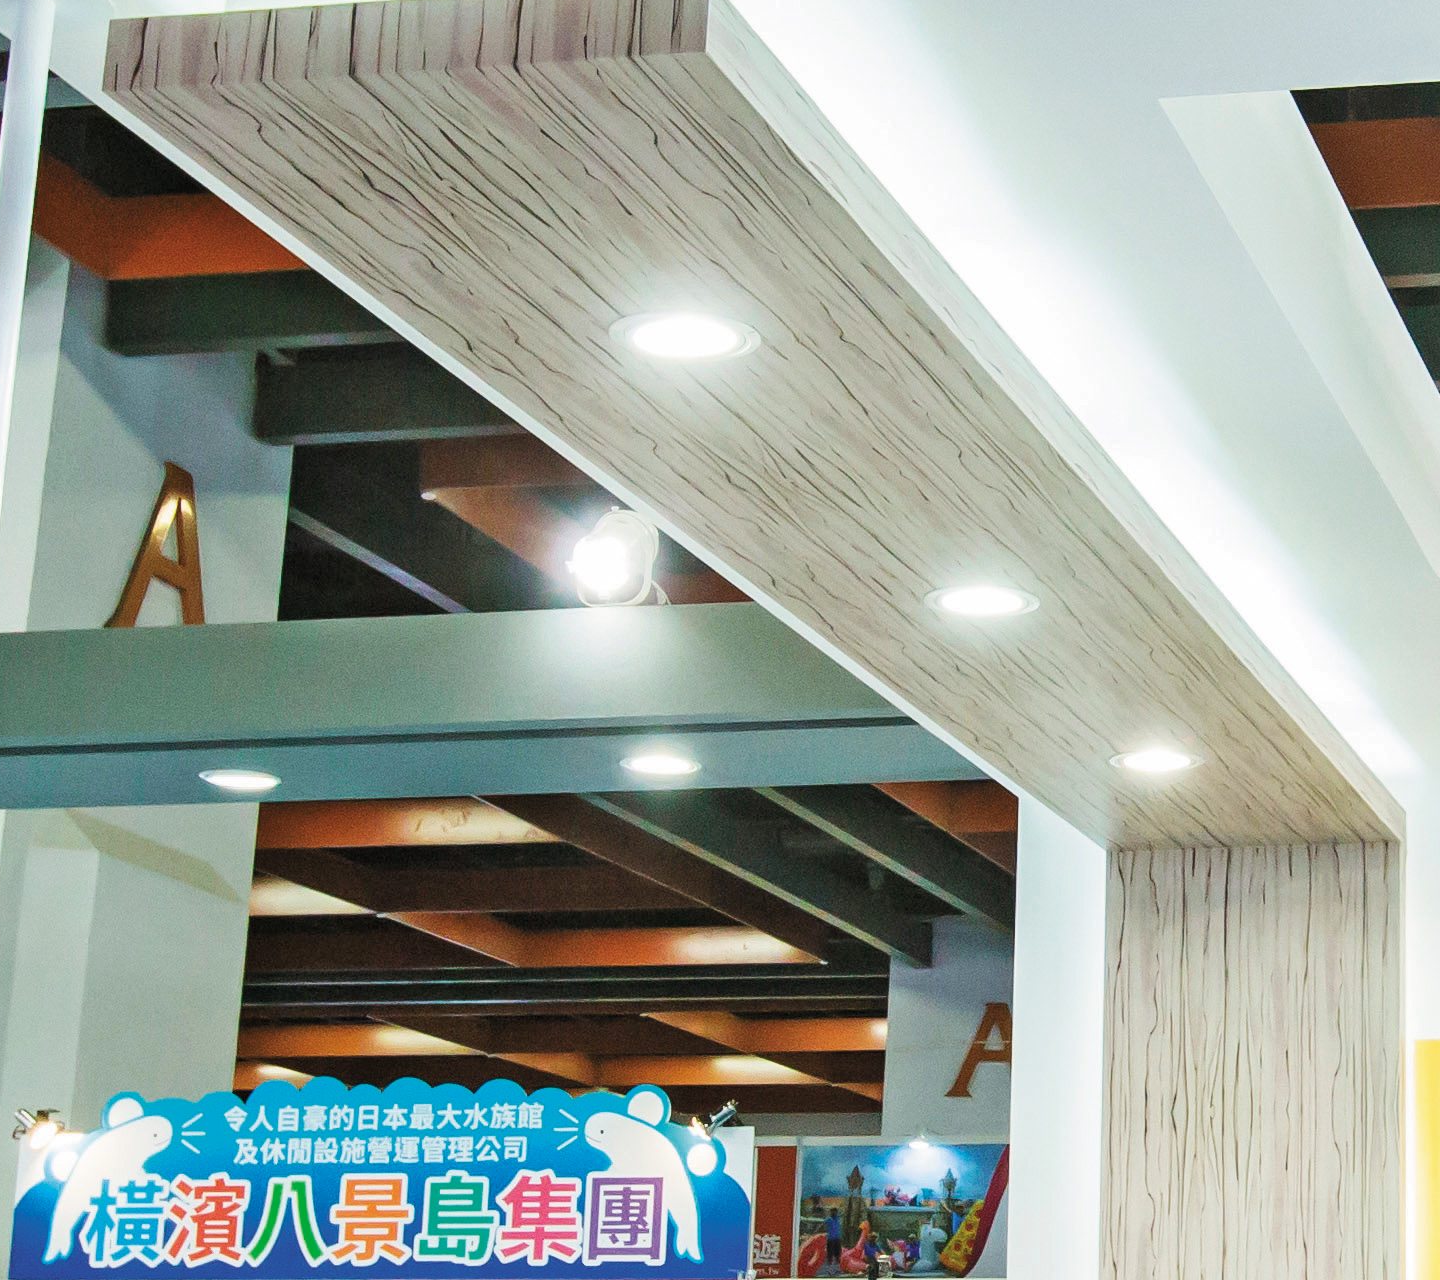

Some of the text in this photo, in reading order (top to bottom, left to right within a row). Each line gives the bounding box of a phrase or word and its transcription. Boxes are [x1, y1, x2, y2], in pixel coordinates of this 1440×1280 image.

[104, 460, 206, 629] A
[223, 1102, 544, 1132] 令人自豪的日本最大水族館
[84, 1174, 669, 1266] 橫濱八景島集團
